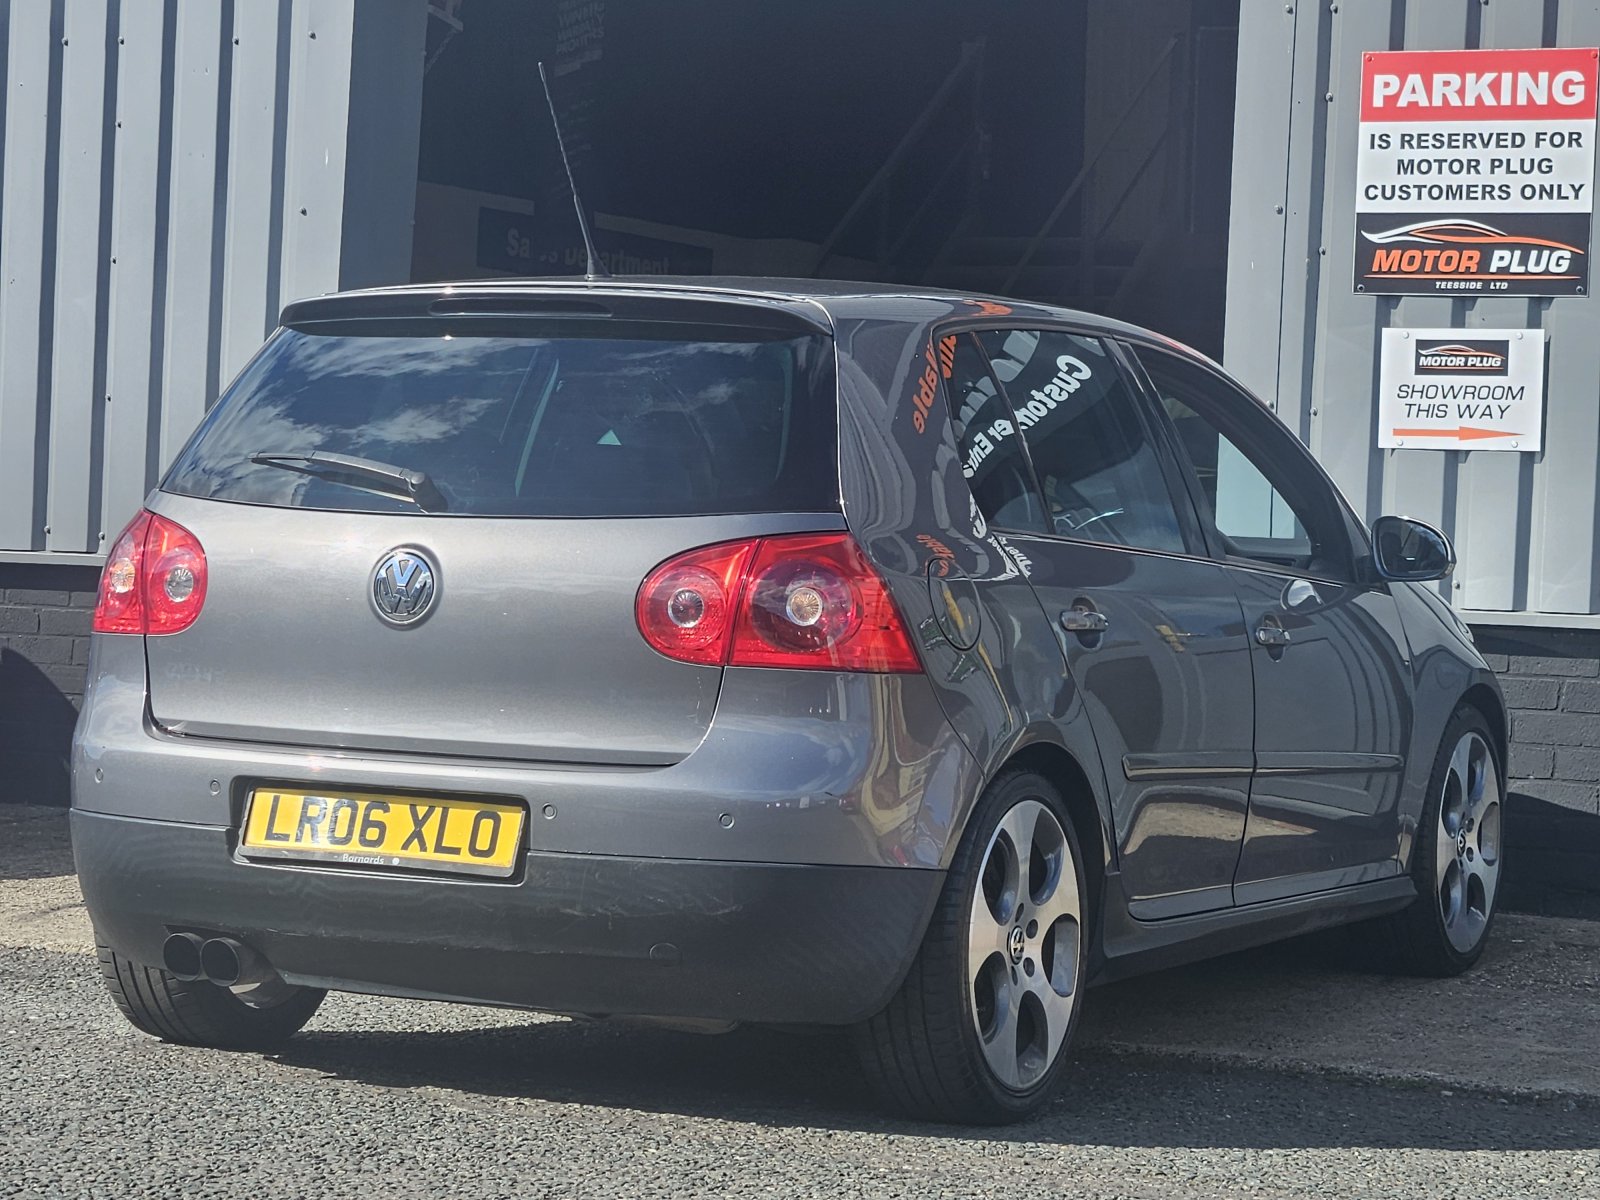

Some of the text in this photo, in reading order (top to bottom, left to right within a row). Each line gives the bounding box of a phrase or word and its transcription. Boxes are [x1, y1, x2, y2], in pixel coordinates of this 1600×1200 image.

[1372, 70, 1585, 107] PARKING
[1369, 131, 1583, 150] IS RESERVED FOR
[1397, 157, 1553, 175] MOTOR PLUG
[1364, 183, 1584, 201] CUSTOMERS ONLY
[1372, 249, 1571, 273] MOTOR PLUG
[1435, 281, 1508, 290] TEESSIDE LTD
[1419, 356, 1501, 367] MOTOR PLUG
[1397, 384, 1525, 401] SHOWROOM
[1405, 403, 1511, 420] THIS WAY
[264, 795, 501, 859] LR06 XLO
[342, 853, 385, 865] Barnards
